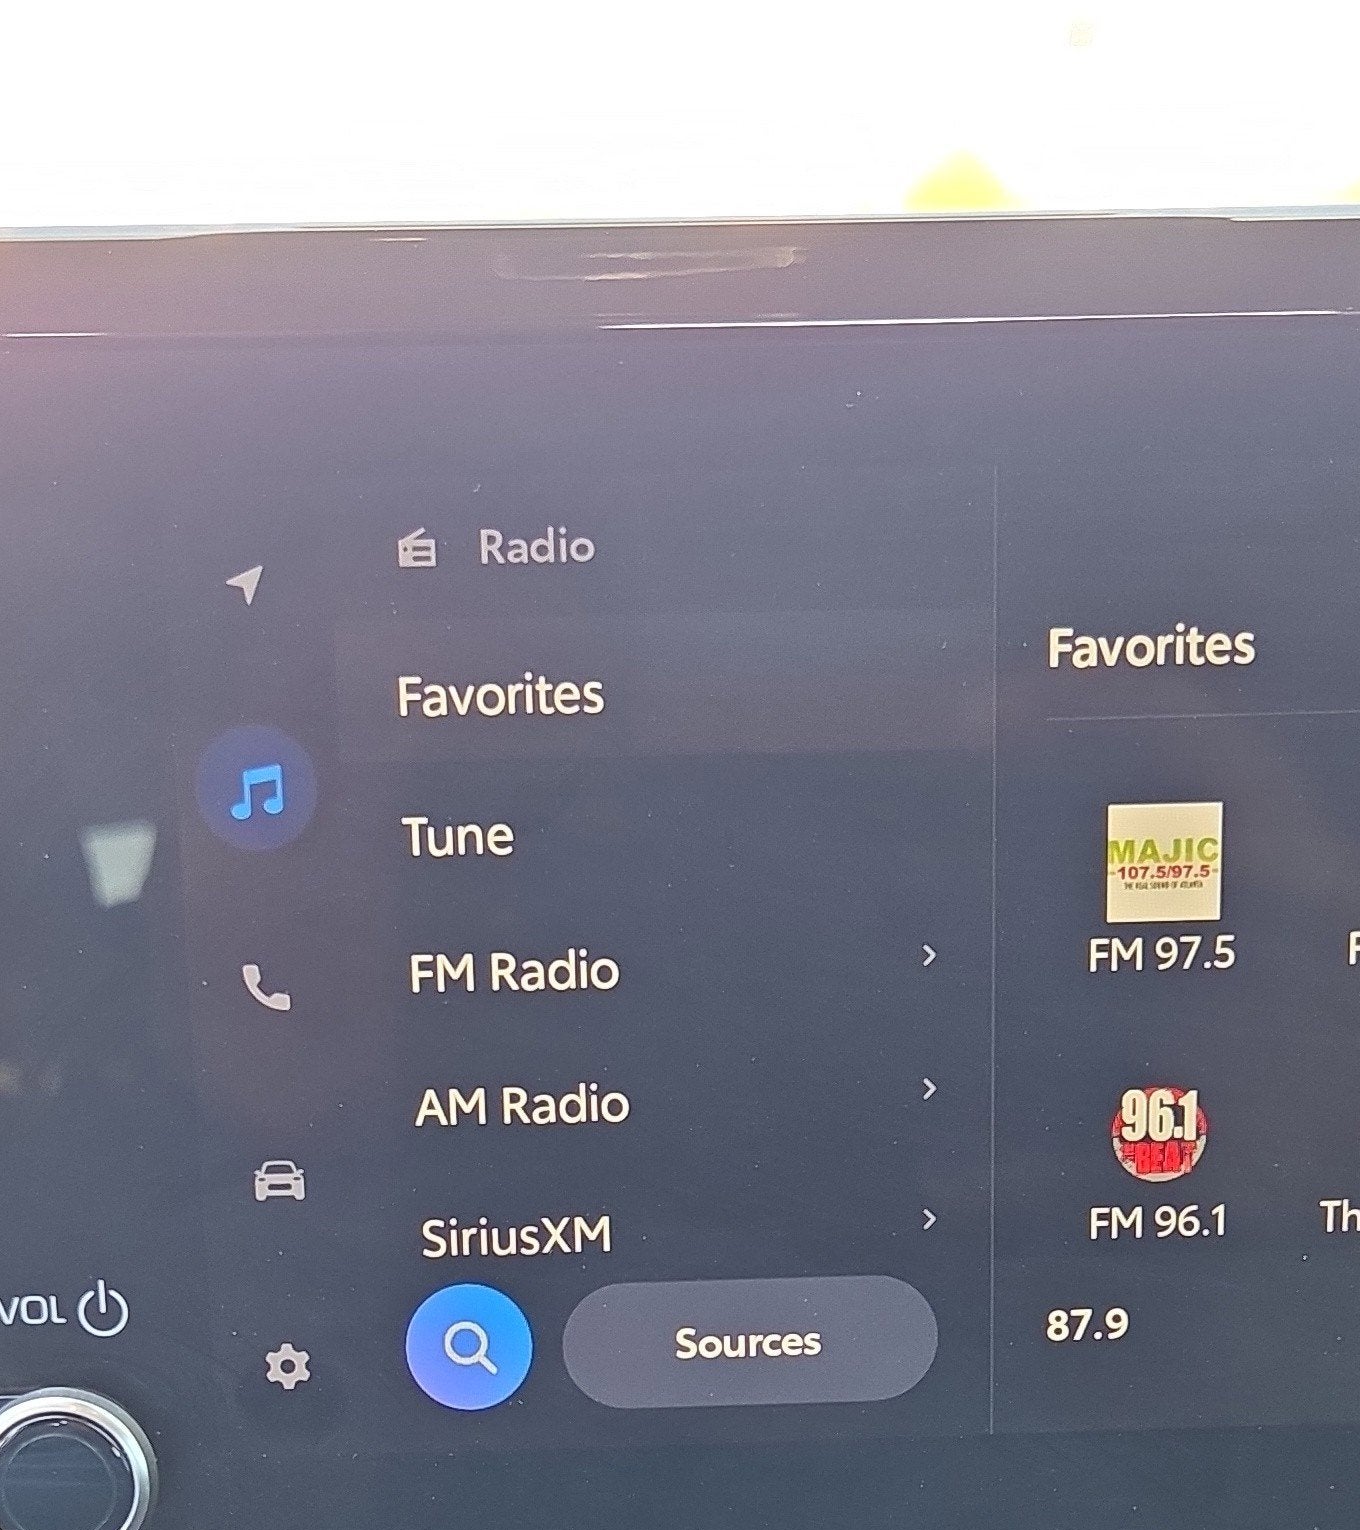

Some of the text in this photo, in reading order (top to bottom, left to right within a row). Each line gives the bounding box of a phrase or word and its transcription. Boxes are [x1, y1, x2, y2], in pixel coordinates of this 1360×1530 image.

[480, 525, 595, 564] Radio
[1049, 622, 1256, 669] Favorites
[398, 671, 604, 718] Favorites
[401, 816, 514, 857] Tune
[1109, 837, 1219, 864] MAJIC
[410, 948, 620, 993] FM Radio
[1089, 934, 1235, 973] FM 97.5
[415, 1082, 630, 1127] AM Radio
[1121, 1089, 1198, 1142] 96.1
[422, 1215, 611, 1258] SiriusXM
[1090, 1204, 1225, 1240] FM 96.1
[675, 1327, 822, 1359] Sources
[1046, 1307, 1129, 1342] 87.9
